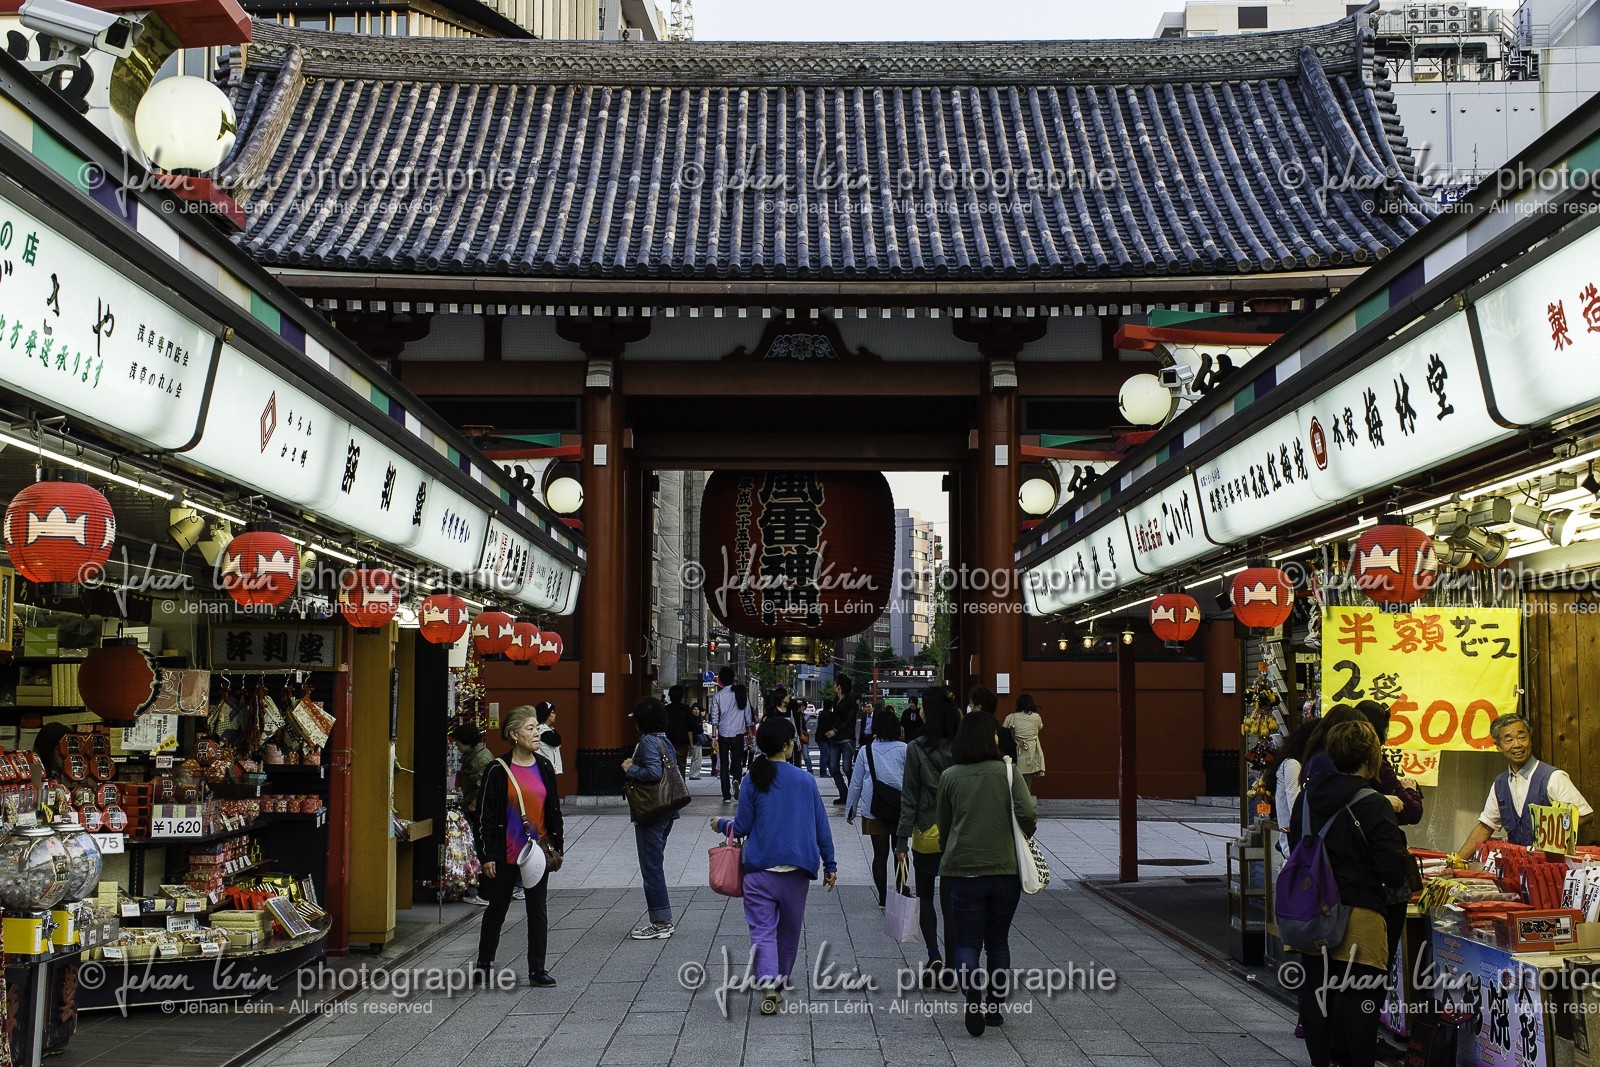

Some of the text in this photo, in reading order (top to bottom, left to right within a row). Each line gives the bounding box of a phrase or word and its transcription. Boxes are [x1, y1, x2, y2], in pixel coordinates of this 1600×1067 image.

[1363, 353, 1455, 450] 梅林堂
[1337, 612, 1448, 655] 半額
[1539, 808, 1566, 850] 500
